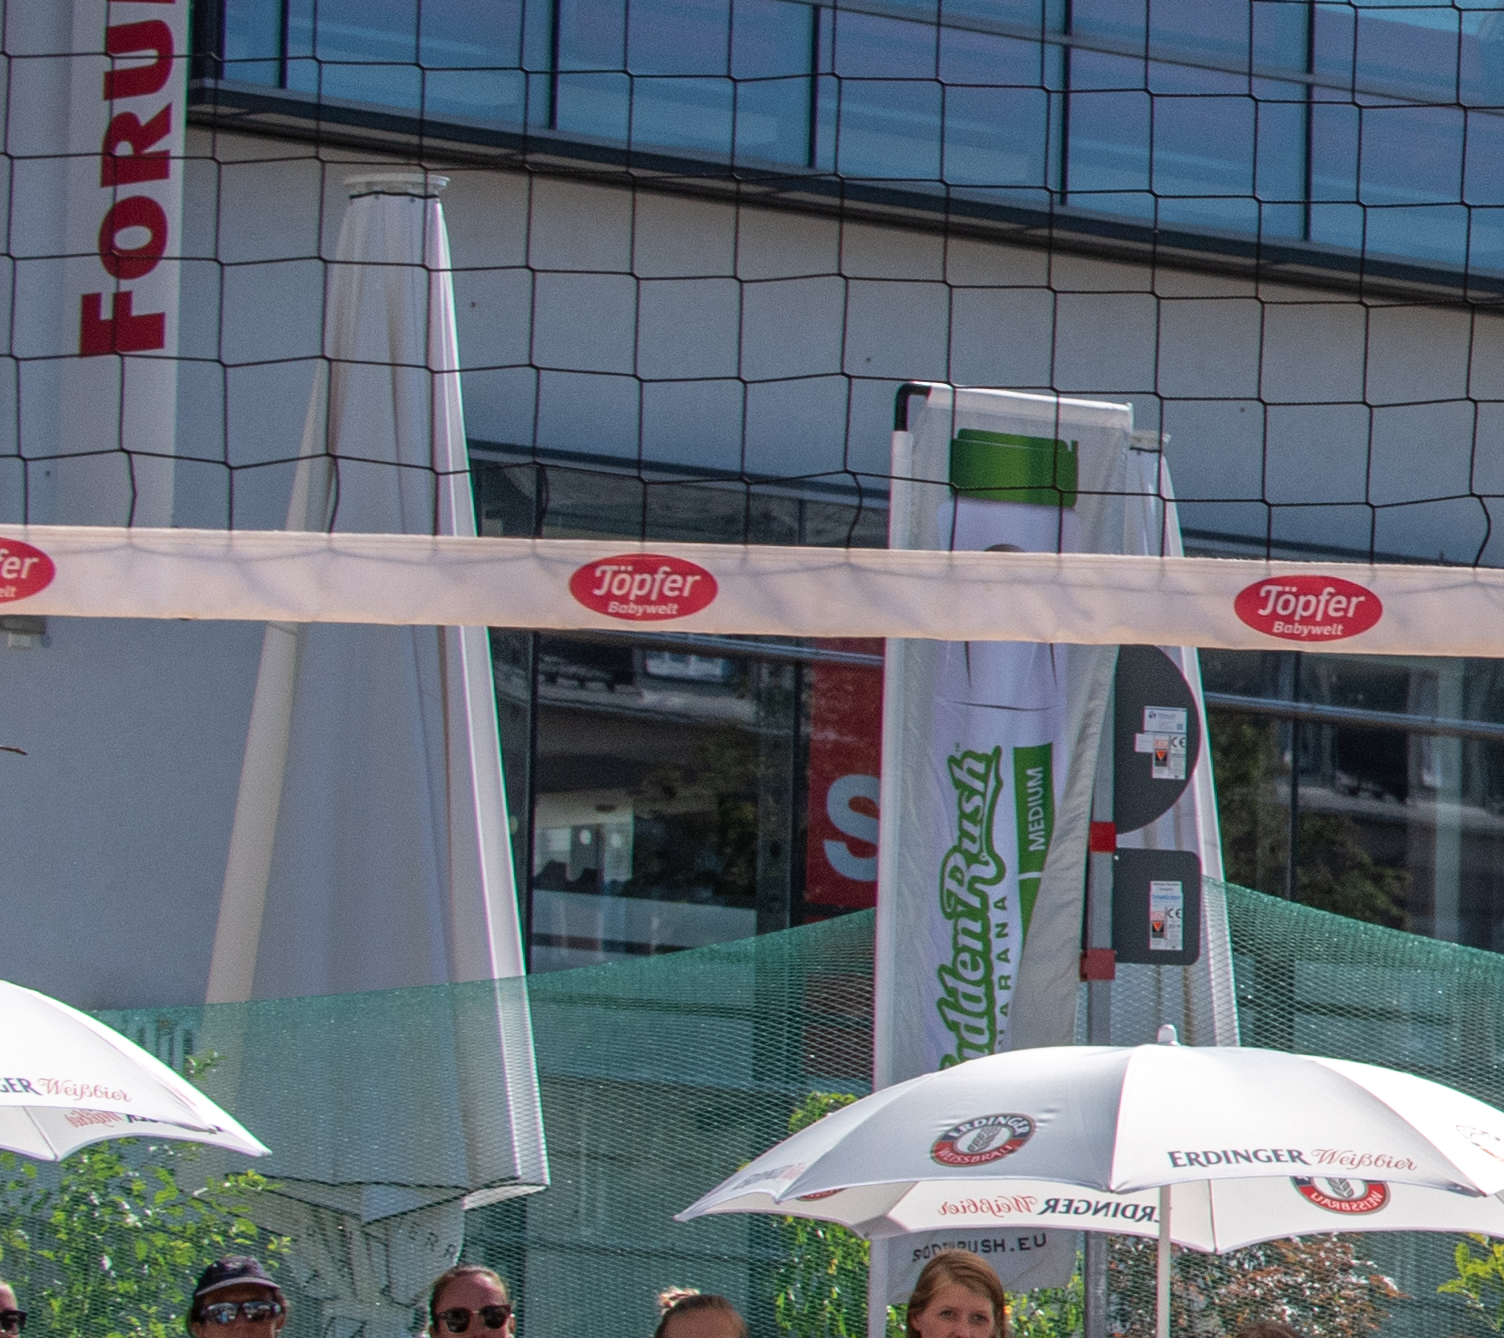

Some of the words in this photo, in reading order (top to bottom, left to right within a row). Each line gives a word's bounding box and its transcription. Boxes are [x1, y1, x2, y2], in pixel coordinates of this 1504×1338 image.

[592, 564, 702, 601] Töpfer
[607, 600, 679, 622] Babywelt
[1257, 584, 1366, 622] Töpfer
[1272, 621, 1344, 638] Babywelt
[1026, 766, 1046, 852] MEDIUM
[38, 1077, 132, 1103] Weißbier
[946, 1113, 1035, 1140] ERDINGER
[1166, 1148, 1309, 1170] ERDINGER
[1309, 1147, 1418, 1172] Weißbier
